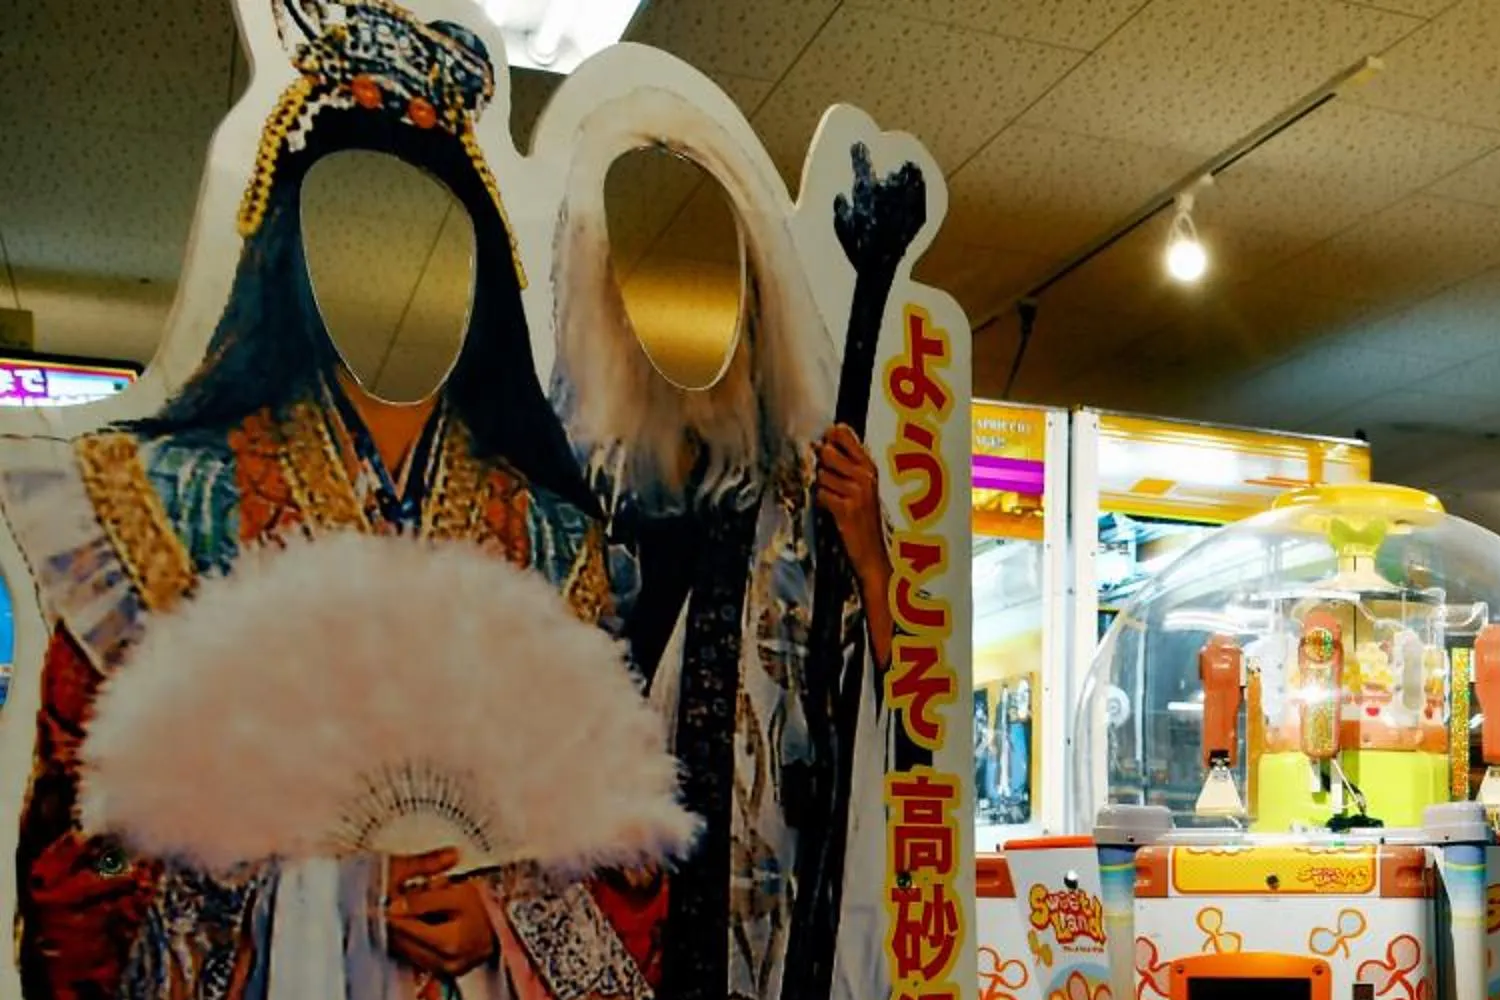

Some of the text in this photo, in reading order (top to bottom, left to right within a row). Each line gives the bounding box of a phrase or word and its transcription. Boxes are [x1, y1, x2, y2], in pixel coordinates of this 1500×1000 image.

[887, 310, 952, 744] ようこそ
[1028, 883, 1090, 930] Sweet
